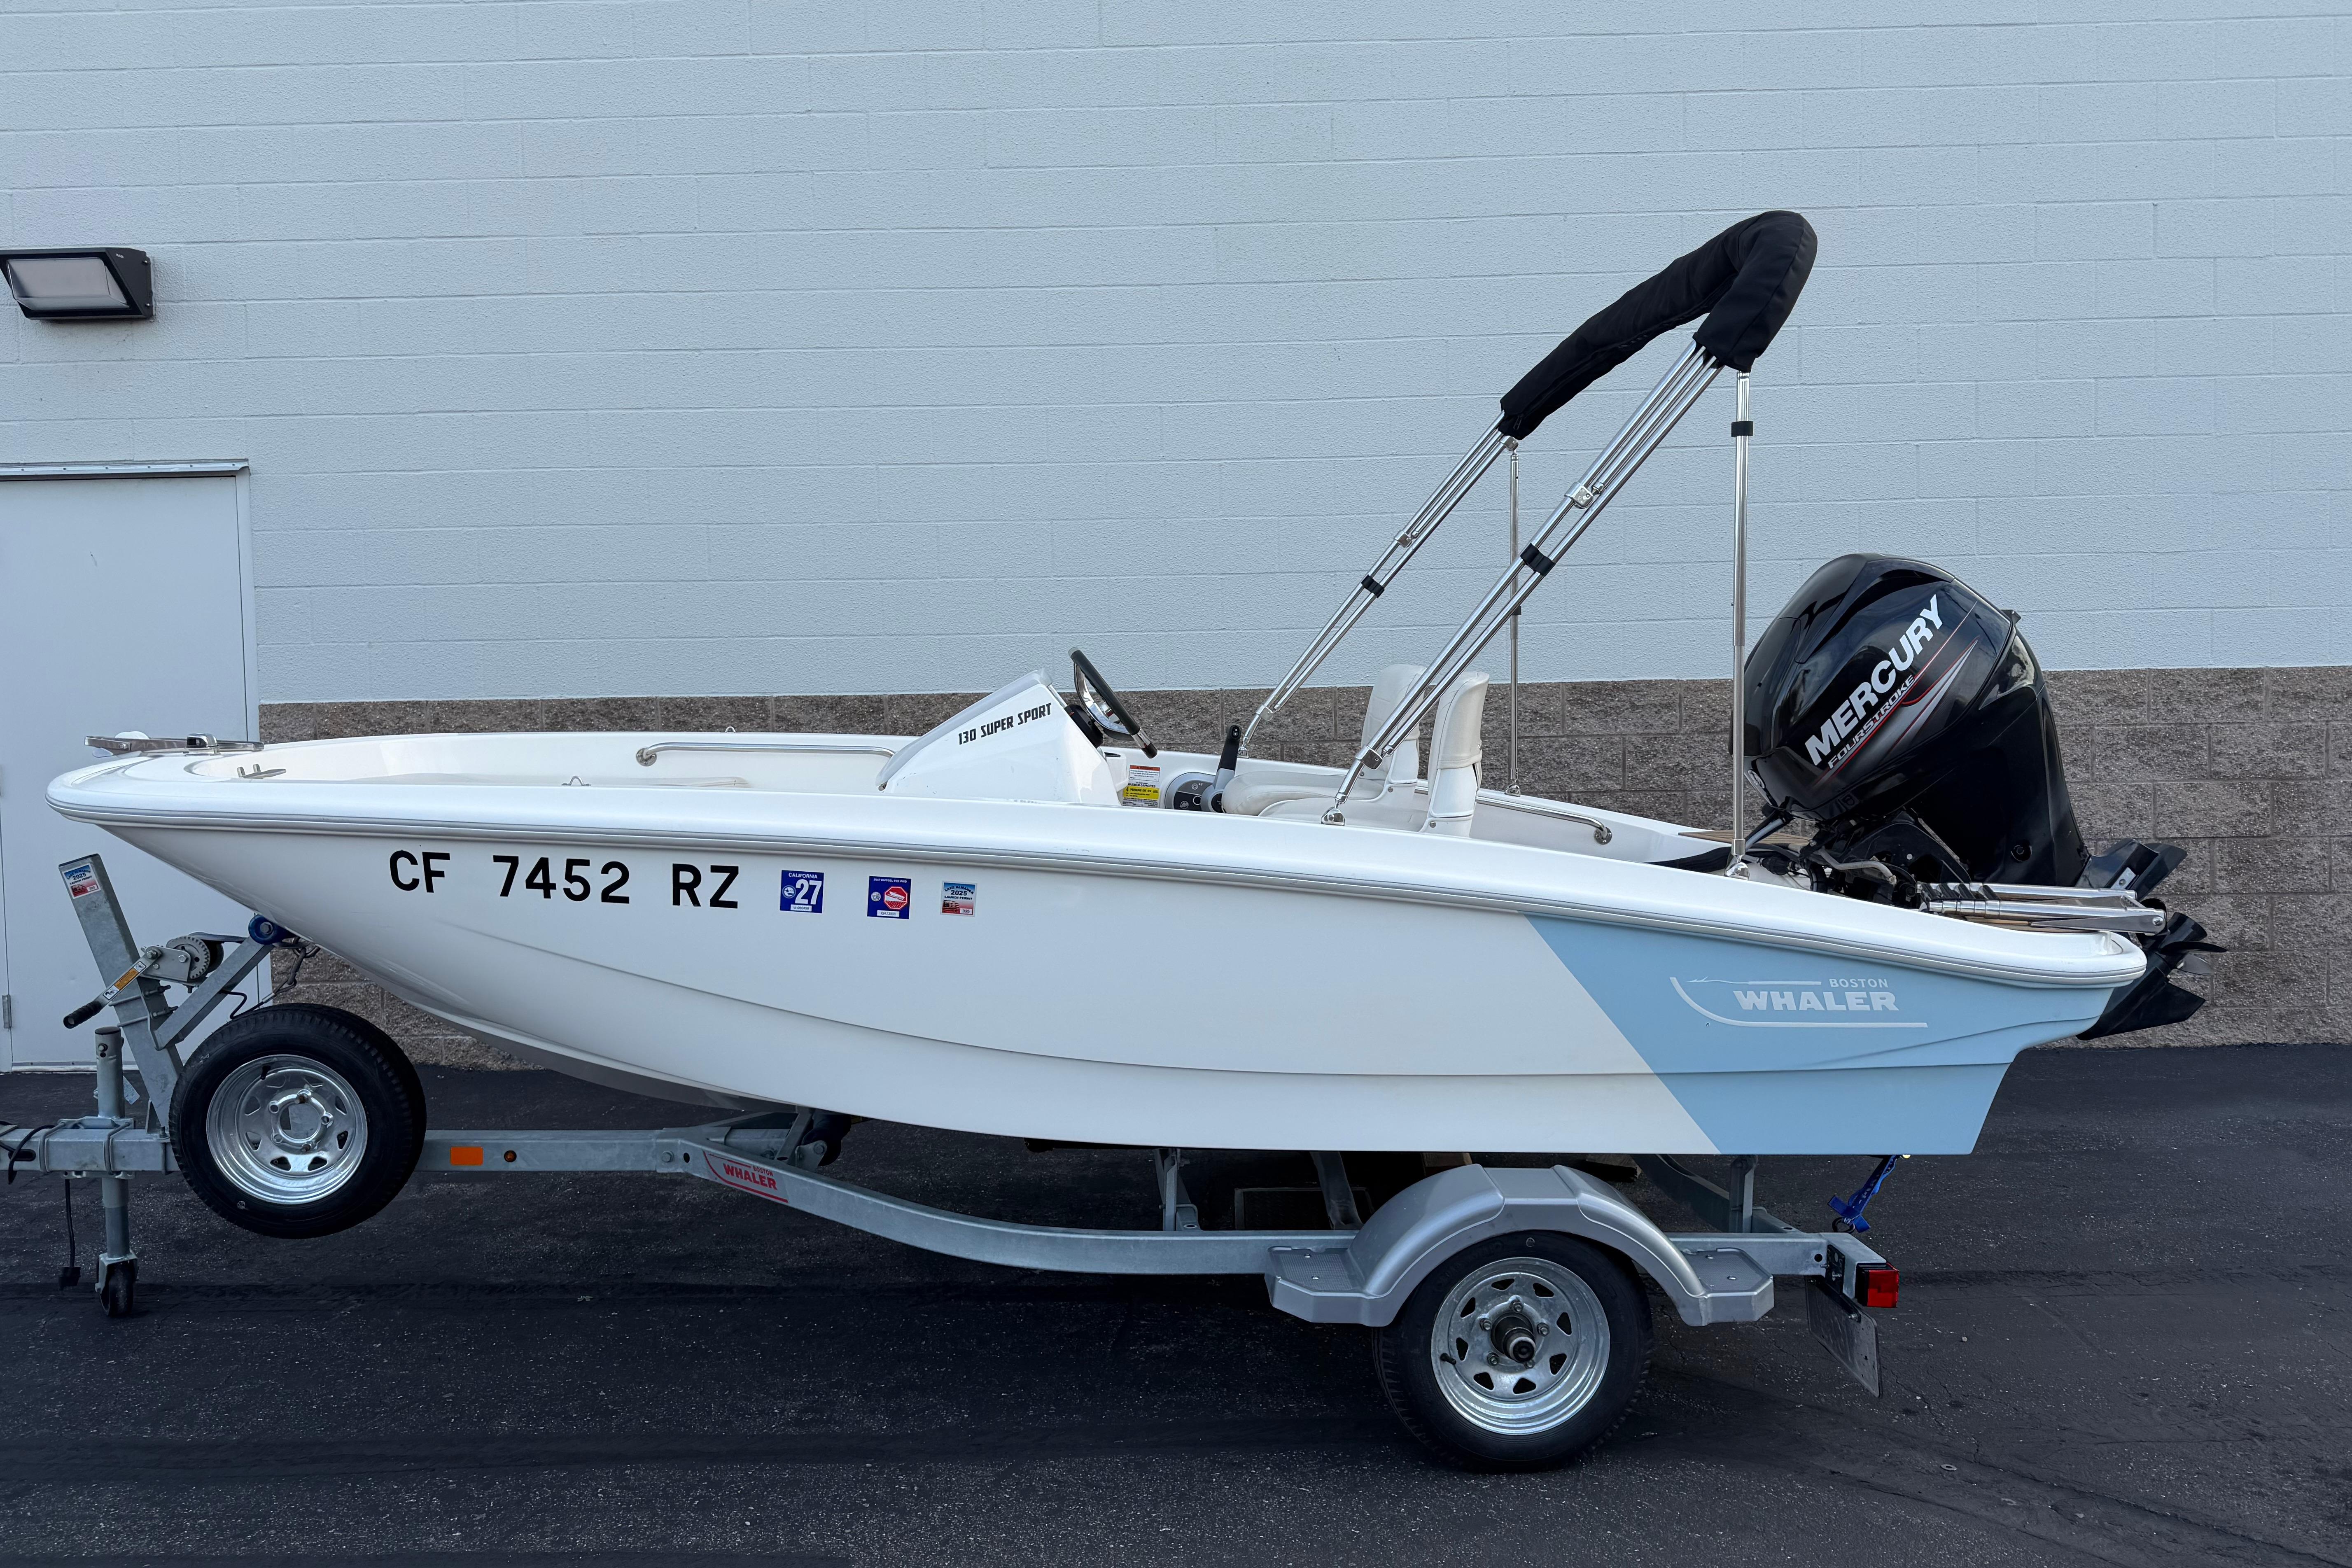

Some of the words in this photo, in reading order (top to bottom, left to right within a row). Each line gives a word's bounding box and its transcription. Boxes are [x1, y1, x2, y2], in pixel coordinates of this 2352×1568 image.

[1804, 594, 1944, 766] MERCURY
[958, 728, 977, 745] 130
[980, 716, 1014, 738] SUPER
[1017, 702, 1052, 726] SPORT
[1827, 674, 1916, 769] FOURSTROKE
[72, 872, 86, 880] 2025
[390, 850, 450, 893] CF
[493, 855, 630, 904] 7452
[672, 863, 739, 909] RZ
[795, 879, 822, 905] 27
[956, 885, 974, 894] ALMANOR
[1829, 978, 1888, 988] BOSTON
[1733, 991, 1899, 1011] WHALER
[723, 1163, 777, 1190] WHALER
[753, 1165, 773, 1176] BOSTON
